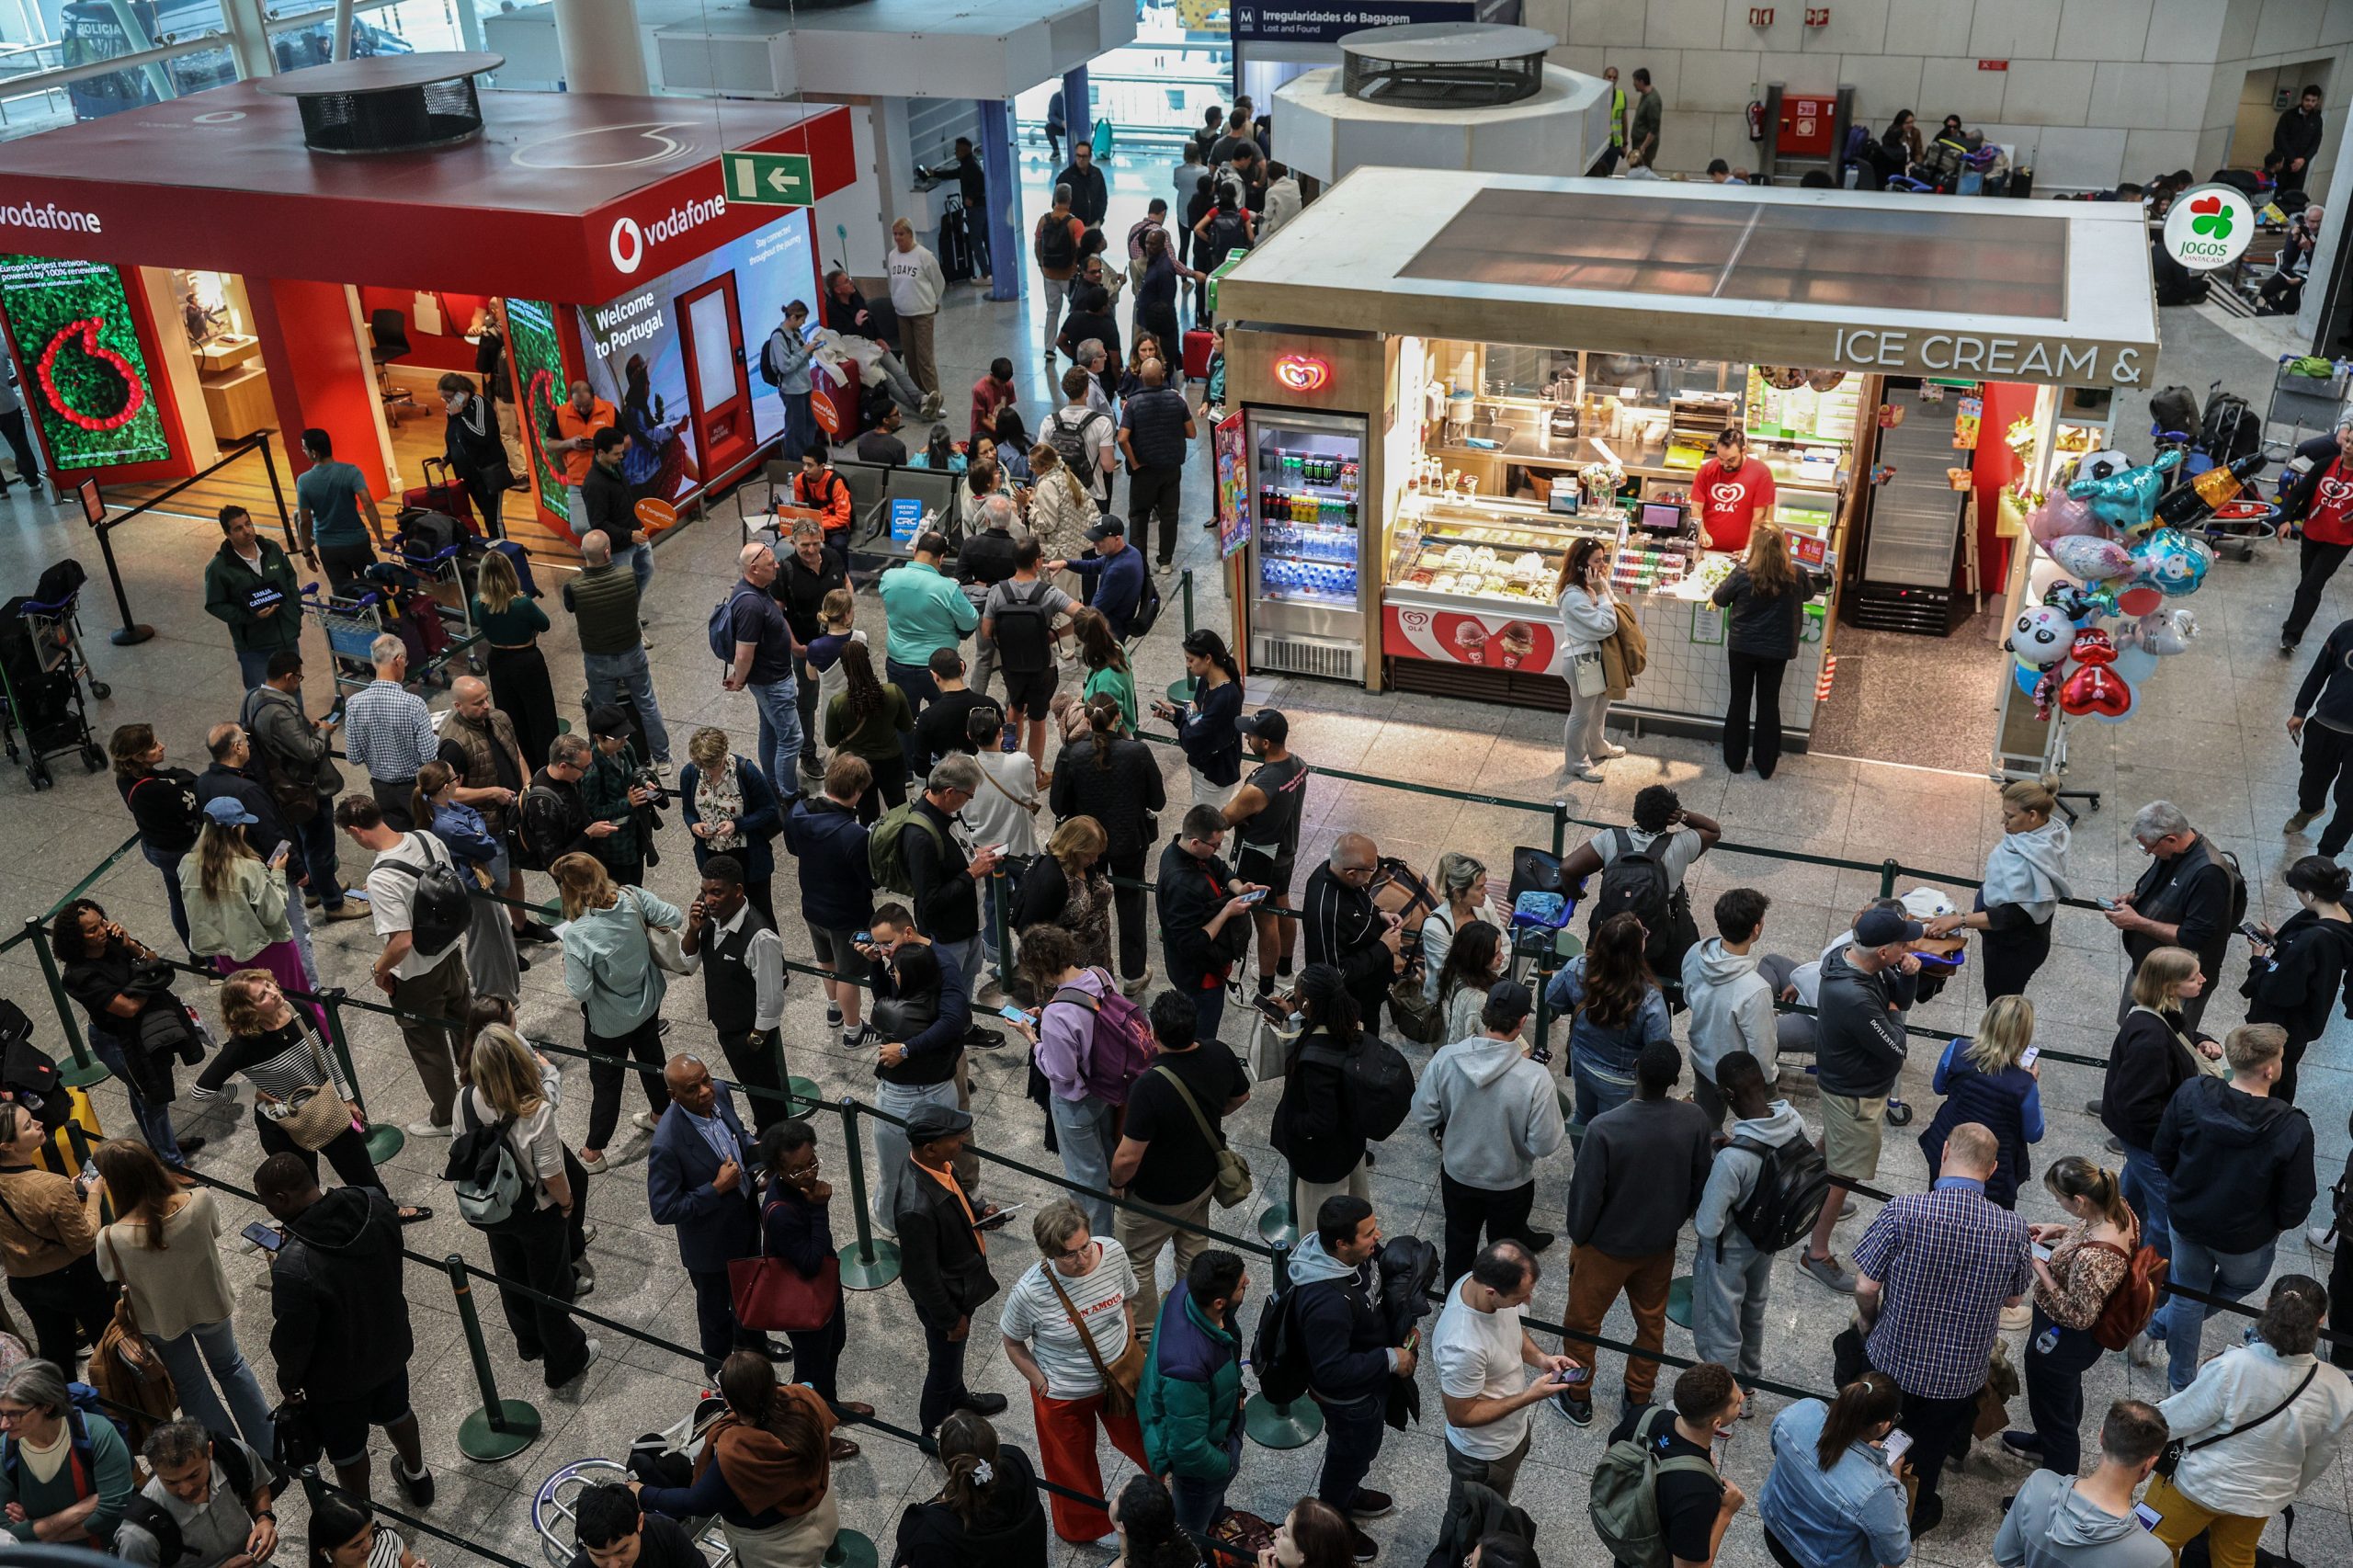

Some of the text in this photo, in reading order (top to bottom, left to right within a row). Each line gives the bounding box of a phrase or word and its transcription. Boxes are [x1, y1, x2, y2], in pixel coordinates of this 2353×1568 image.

[1263, 9, 1410, 26] Irregularidades de Bagagem
[1263, 24, 1279, 32] Lost
[1280, 25, 1295, 33] and
[1296, 25, 1321, 33] Found
[643, 194, 726, 247] vodafone
[756, 224, 791, 249] Stay connected
[749, 234, 801, 266] throughout the journey
[2179, 241, 2228, 256] JOGOS
[0, 263, 31, 274] Europe's
[31, 261, 58, 271] largest
[1, 265, 110, 281] powered by 100% renewables
[596, 290, 654, 332] Welcome
[595, 309, 664, 359] to Portugal
[1834, 328, 2142, 383] ICE CREAM &
[249, 592, 283, 608] CATHARINA
[252, 588, 273, 599] TANJA
